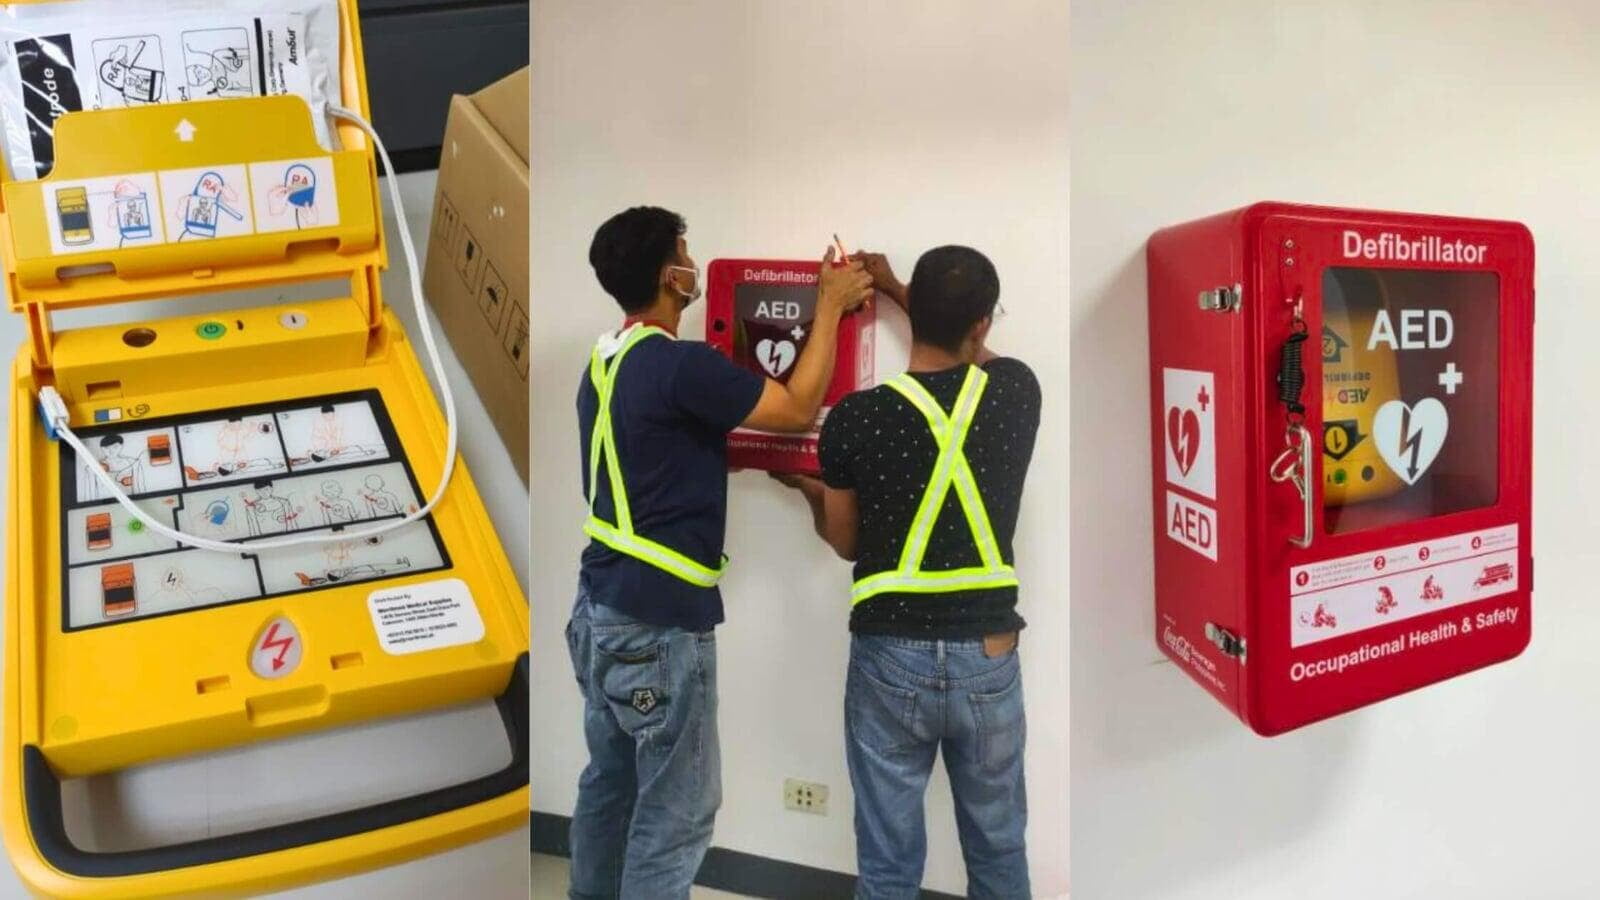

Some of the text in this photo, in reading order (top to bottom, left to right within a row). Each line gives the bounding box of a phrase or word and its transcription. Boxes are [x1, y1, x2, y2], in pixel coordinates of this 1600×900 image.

[1342, 230, 1488, 265] Defibrillator
[743, 268, 820, 284] Defibrillator
[754, 300, 801, 320] AED
[1366, 308, 1455, 351] AED
[1171, 501, 1212, 549] AED
[1289, 605, 1519, 683] Occupational Health & Safety
